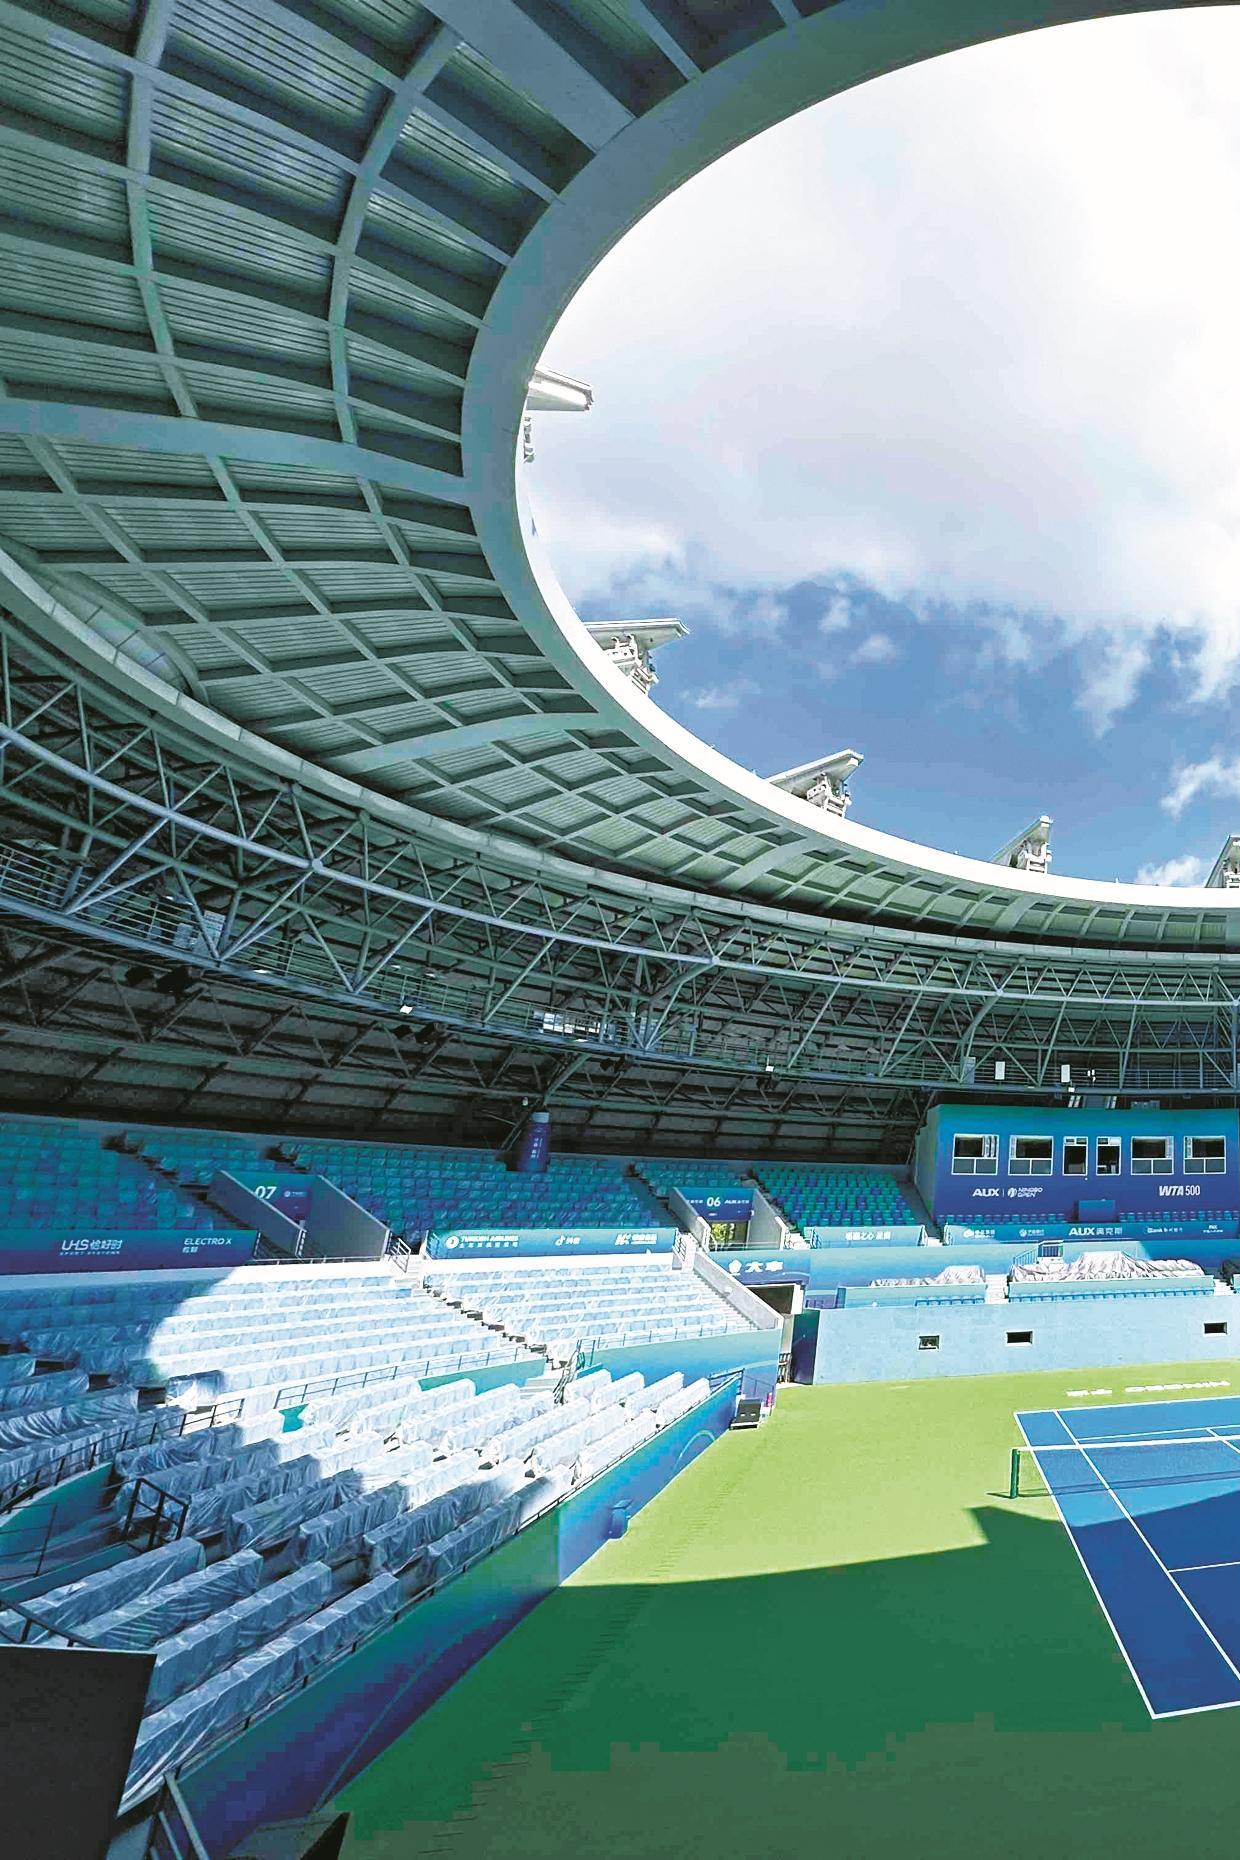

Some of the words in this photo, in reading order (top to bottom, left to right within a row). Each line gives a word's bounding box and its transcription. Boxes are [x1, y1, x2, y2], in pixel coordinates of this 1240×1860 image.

[255, 1185, 277, 1200] 07
[972, 1188, 1000, 1197] AUX
[1159, 1185, 1184, 1196] WTA
[1185, 1185, 1201, 1196] 500
[706, 1197, 721, 1207] 06
[1068, 1227, 1095, 1236] AUX
[61, 1239, 90, 1251] UHS
[184, 1237, 225, 1246] ELECTRO
